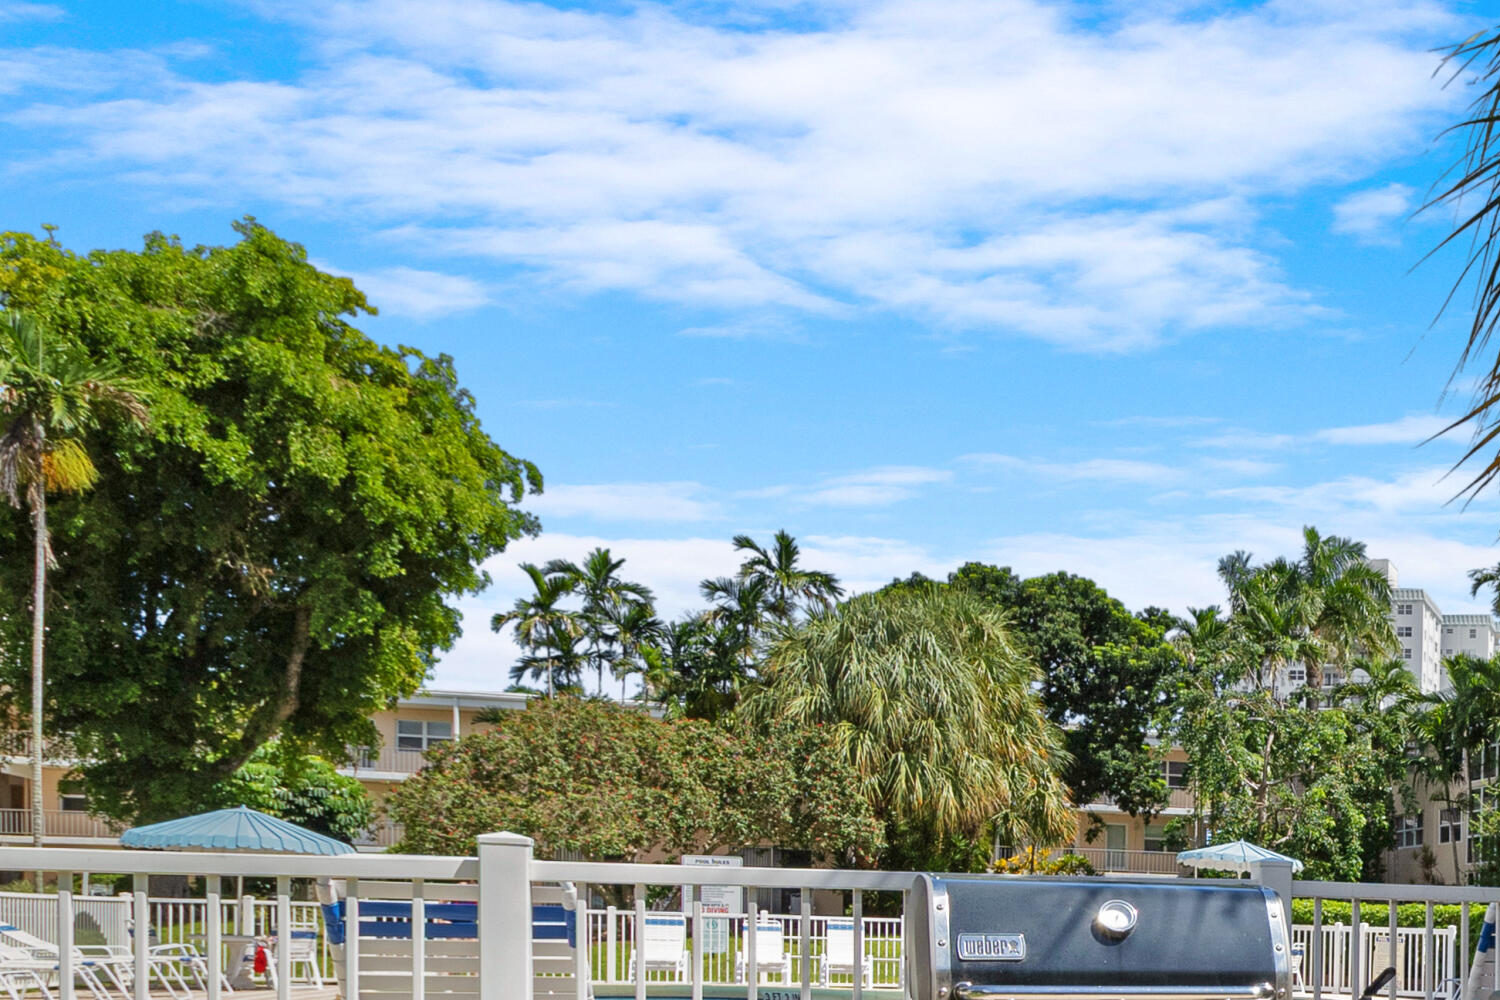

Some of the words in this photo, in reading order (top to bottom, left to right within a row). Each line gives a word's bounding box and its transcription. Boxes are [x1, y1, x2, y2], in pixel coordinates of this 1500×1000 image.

[964, 935, 1008, 955] weber
[764, 993, 771, 1000] 3
[772, 993, 782, 1000] FT
